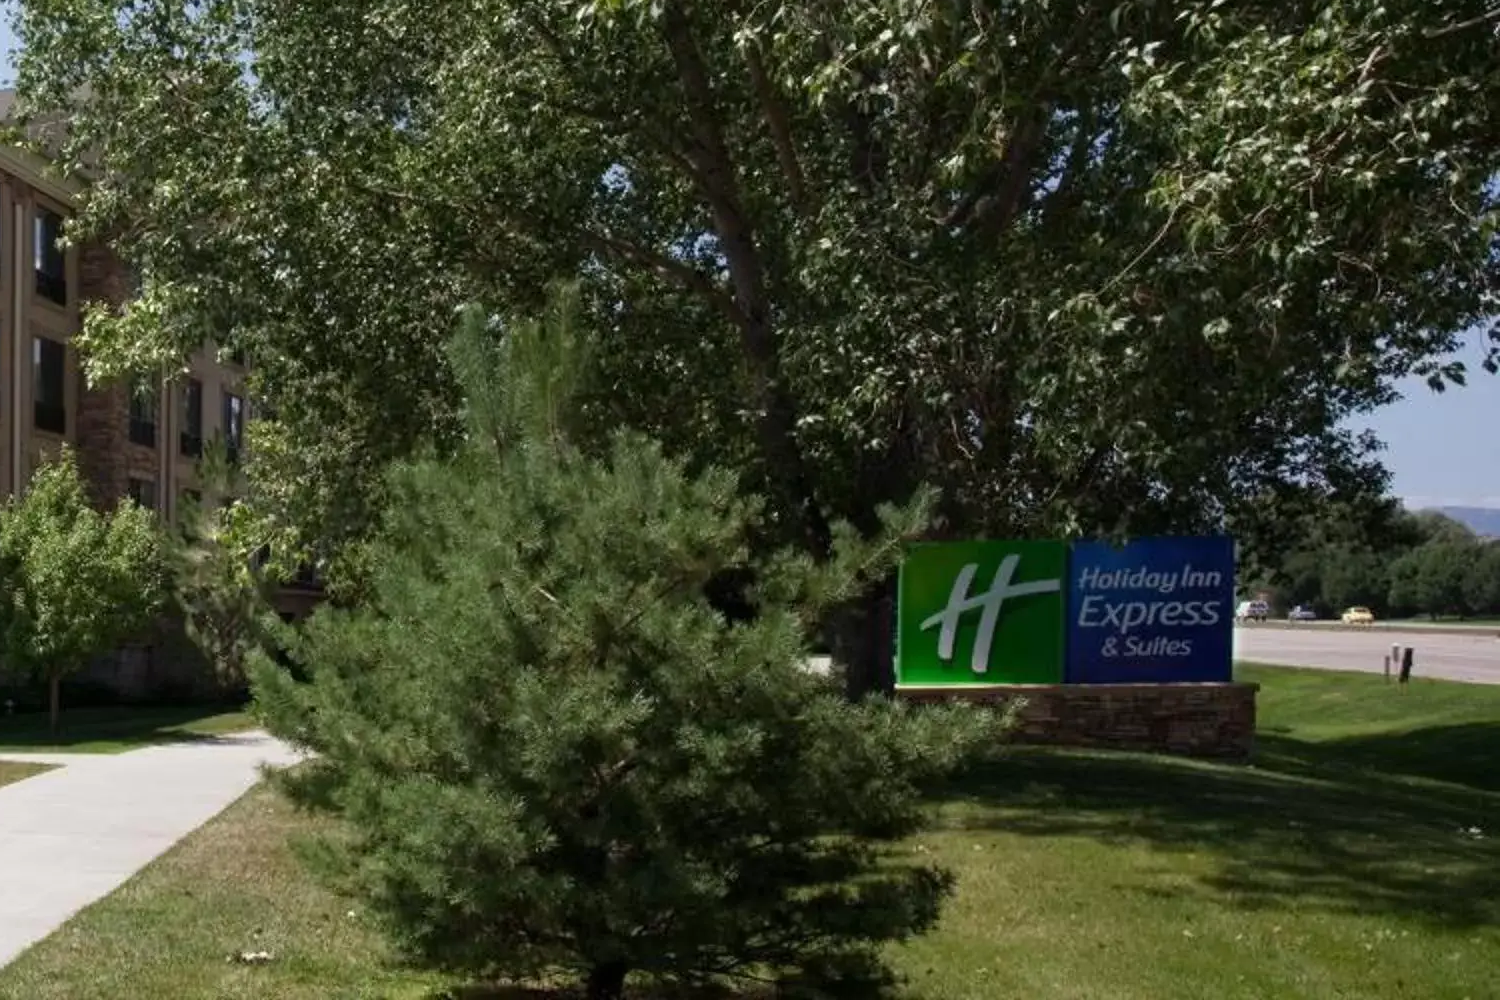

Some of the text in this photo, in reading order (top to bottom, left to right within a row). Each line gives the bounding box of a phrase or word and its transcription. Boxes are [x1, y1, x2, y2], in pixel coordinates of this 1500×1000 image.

[1077, 563, 1222, 593] Holiday Inn
[1077, 595, 1221, 634] Express
[1100, 635, 1193, 657] & Suites
